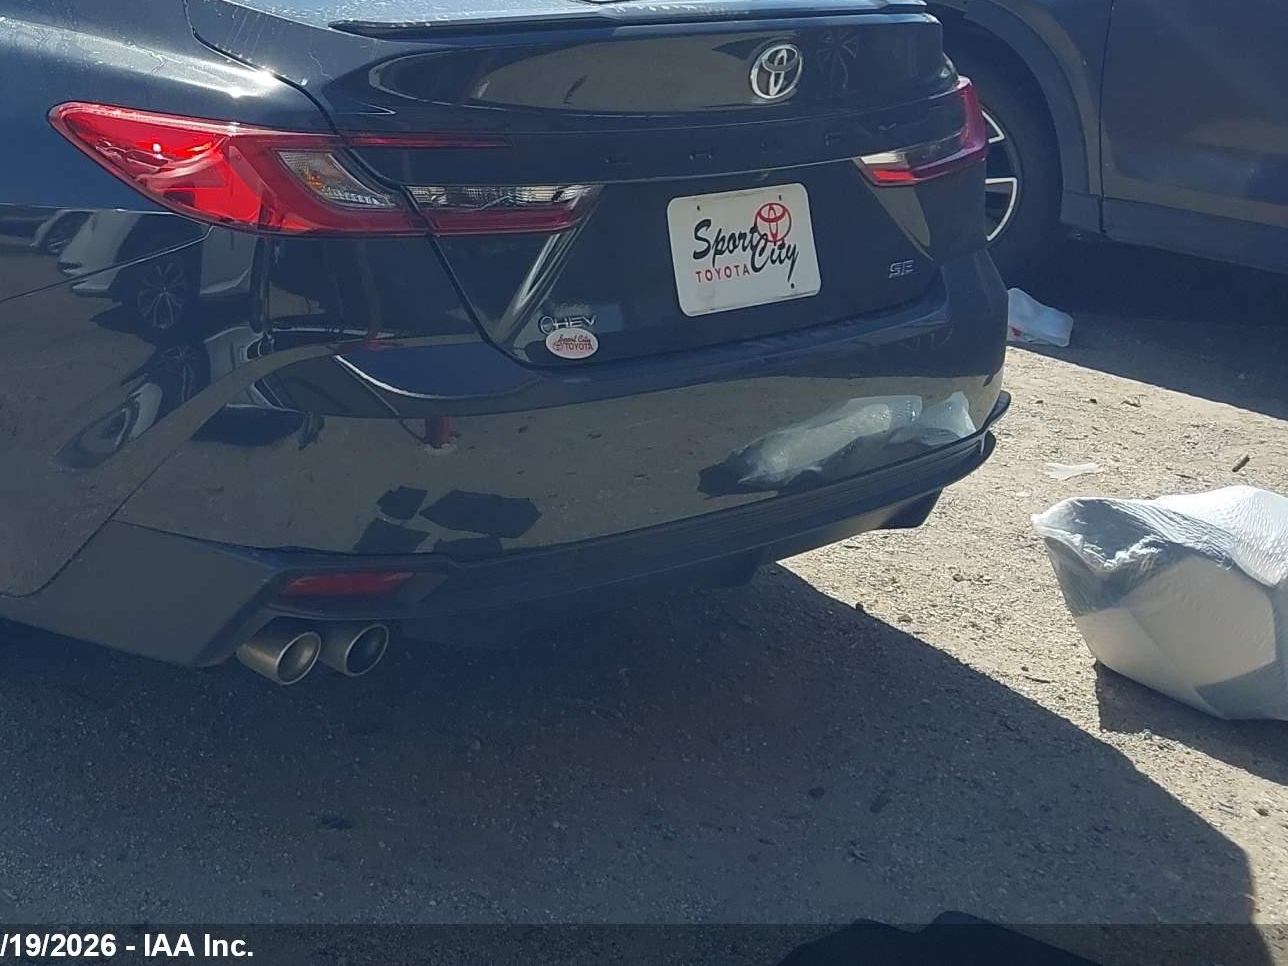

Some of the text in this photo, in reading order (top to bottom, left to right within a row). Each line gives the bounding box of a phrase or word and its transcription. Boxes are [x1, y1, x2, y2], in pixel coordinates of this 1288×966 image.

[693, 219, 799, 282] Sport City
[696, 265, 750, 283] TOYOTA
[889, 259, 915, 279] SE
[564, 342, 594, 351] TOYOTA
